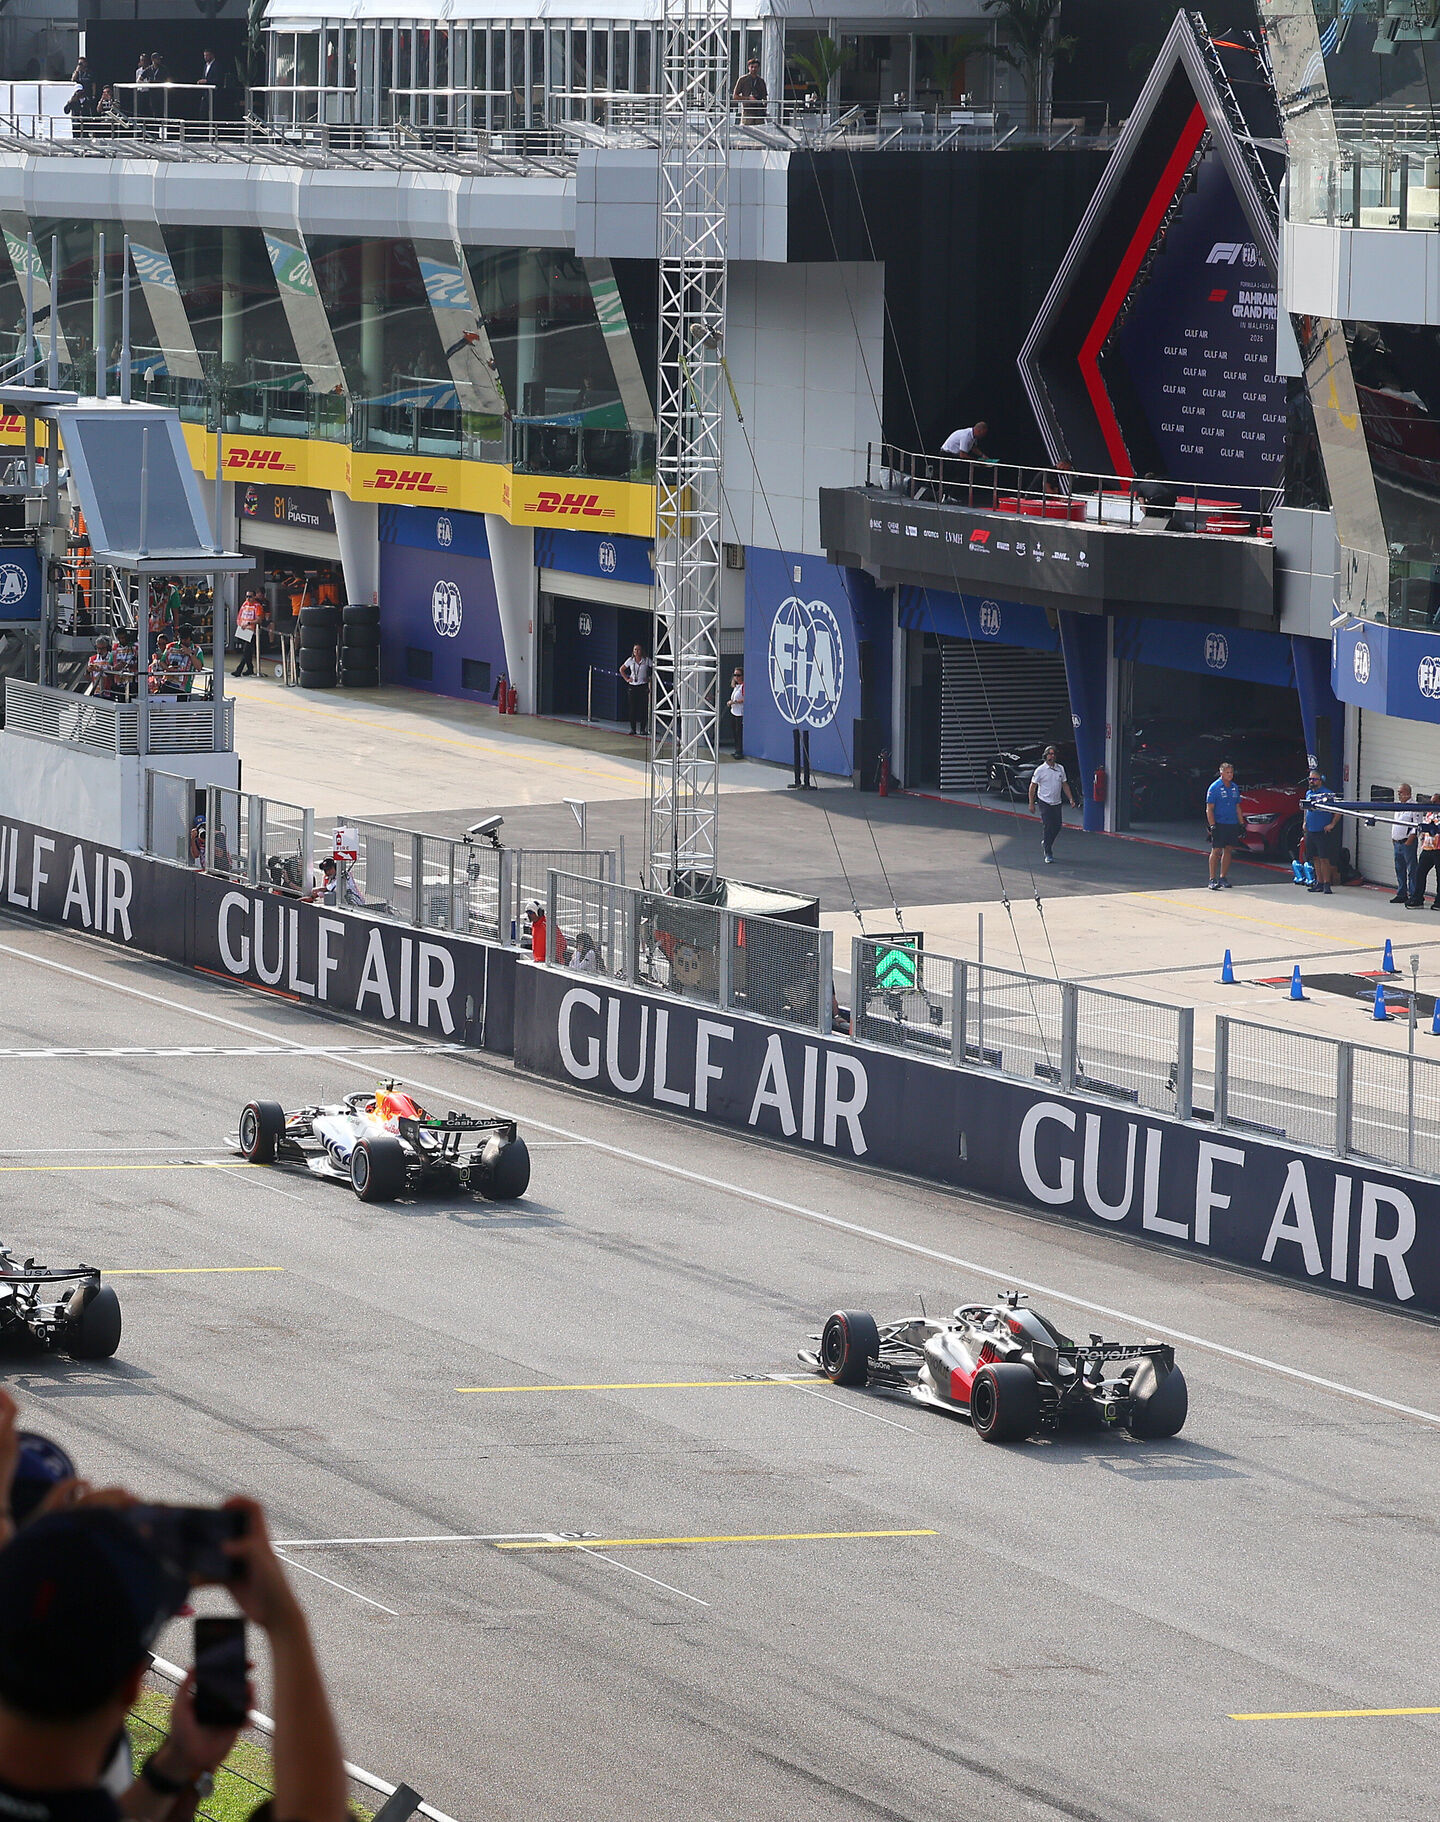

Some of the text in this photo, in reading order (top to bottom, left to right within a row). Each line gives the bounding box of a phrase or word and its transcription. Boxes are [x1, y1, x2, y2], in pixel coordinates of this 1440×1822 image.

[1239, 291, 1277, 306] BAHRAIN
[1232, 305, 1277, 320] GRAND PRI
[1247, 322, 1274, 331] MALAYSIA
[1184, 329, 1208, 339] GULF AIR
[1164, 346, 1187, 356] GULF AIR
[1204, 350, 1228, 360] GULF AIR
[1244, 353, 1268, 363] GULF AIR
[1183, 367, 1207, 377] GULF AIR
[1223, 371, 1247, 381] GULF AIR
[1264, 374, 1278, 384] GULF
[1162, 385, 1186, 395] GULF AIR
[1202, 388, 1226, 399] GULF AIR
[1242, 392, 1267, 402] GULF AIR
[1182, 405, 1205, 416] GULF AIR
[1221, 409, 1246, 420] GULF AIR
[1262, 413, 1287, 423] GULF AIR
[1161, 422, 1185, 433] GULF AIR
[1201, 427, 1225, 437] GULF AIR
[1241, 431, 1266, 441] GULF AIR
[1180, 444, 1204, 454] GULF AIR
[1220, 448, 1244, 459] GULF AIR
[227, 448, 284, 471] DHL
[1261, 452, 1276, 461] GULF
[374, 468, 436, 493] DHL
[274, 496, 285, 519] 81
[536, 491, 602, 516] DHL
[288, 511, 320, 525] PIASTRI
[945, 531, 963, 545] LVMH
[62, 844, 133, 941] AIR
[218, 891, 456, 1035] GULF AIR
[558, 988, 869, 1156] GULF AIR
[1019, 1101, 1417, 1301] GULF AIR
[1075, 1346, 1143, 1361] Revolut
